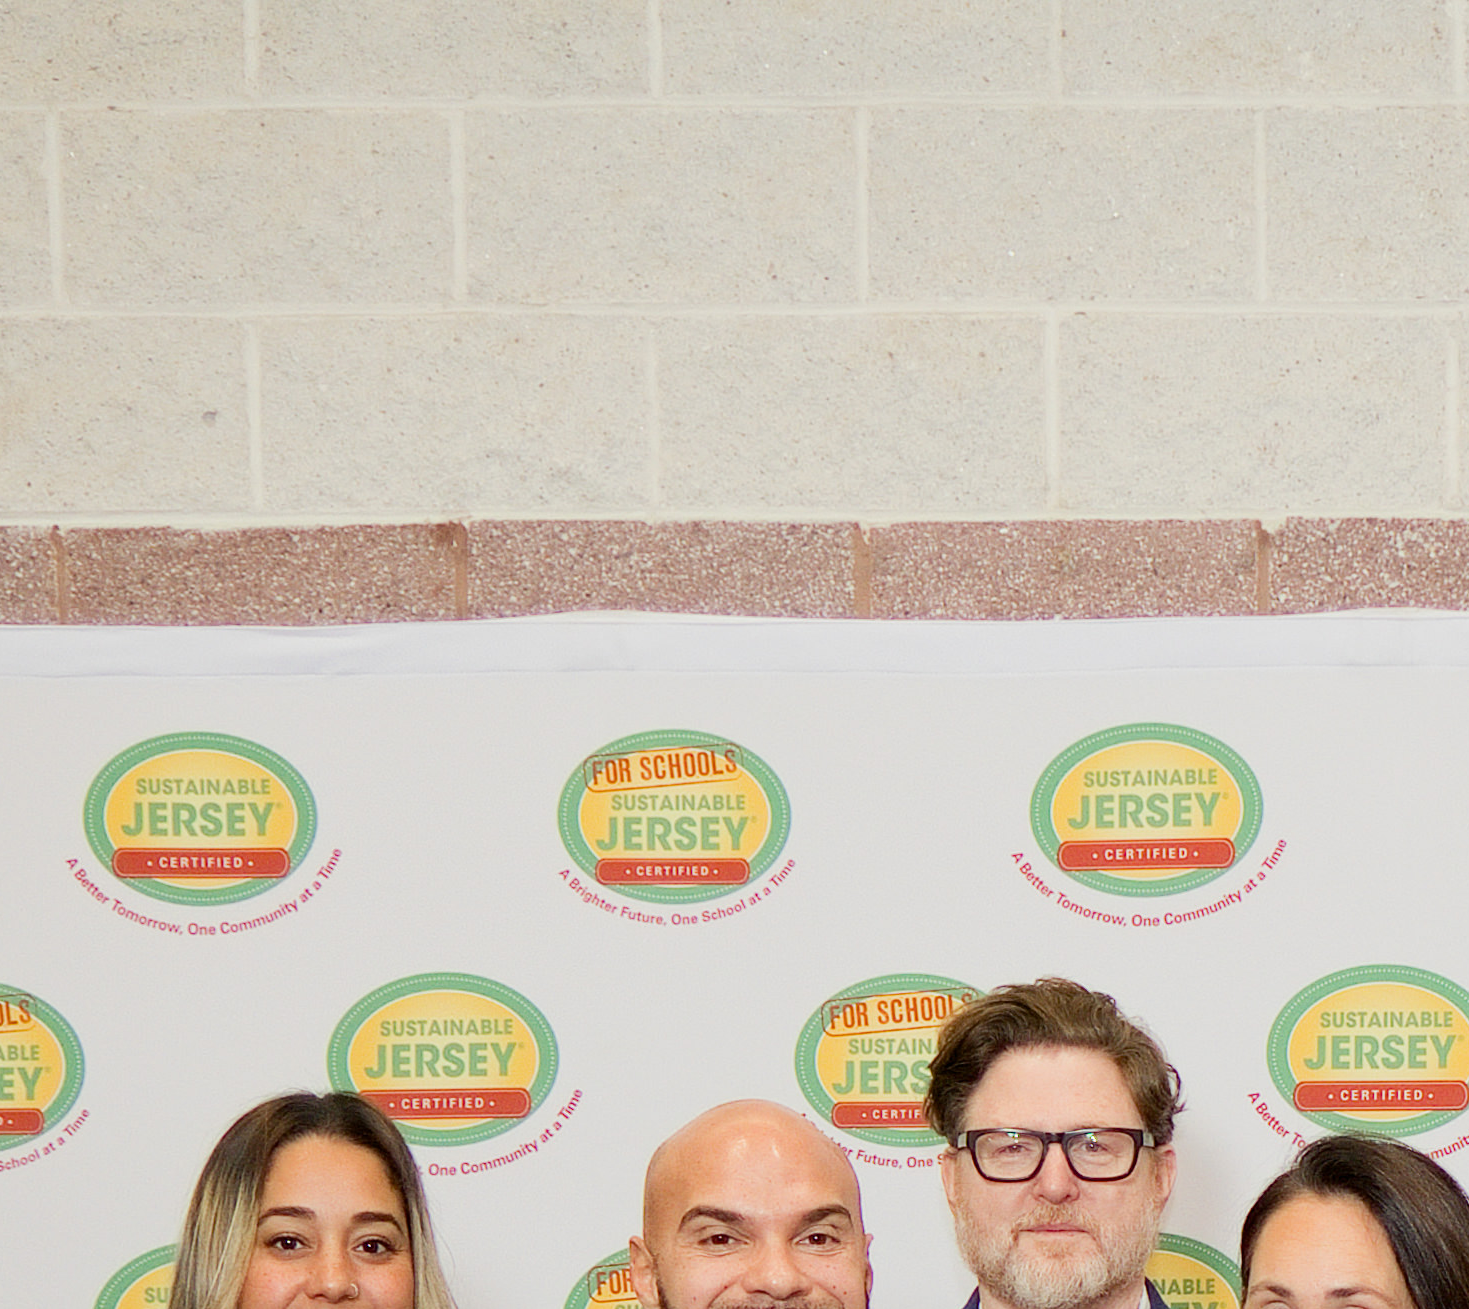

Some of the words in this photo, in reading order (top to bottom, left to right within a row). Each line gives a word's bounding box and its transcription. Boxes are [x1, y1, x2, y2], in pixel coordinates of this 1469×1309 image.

[592, 759, 631, 785] FOR
[640, 750, 737, 781] SCHOOLS
[1083, 769, 1218, 786] SUSTAINABLE
[136, 778, 271, 795] SUSTAINABLE
[611, 795, 745, 811] SUSTAINABLE
[1067, 793, 1221, 828] JERSEY
[121, 802, 275, 837] JERSEY
[596, 816, 749, 851] JERSEY
[1104, 848, 1188, 860] CERTIFIED
[159, 857, 243, 869] CERTIFIED
[636, 866, 709, 877] CERTIFIED
[75, 869, 110, 903] Better
[111, 899, 183, 935] Tomorrow,
[188, 923, 216, 935] One
[220, 900, 298, 934] Community
[317, 849, 342, 880] Time
